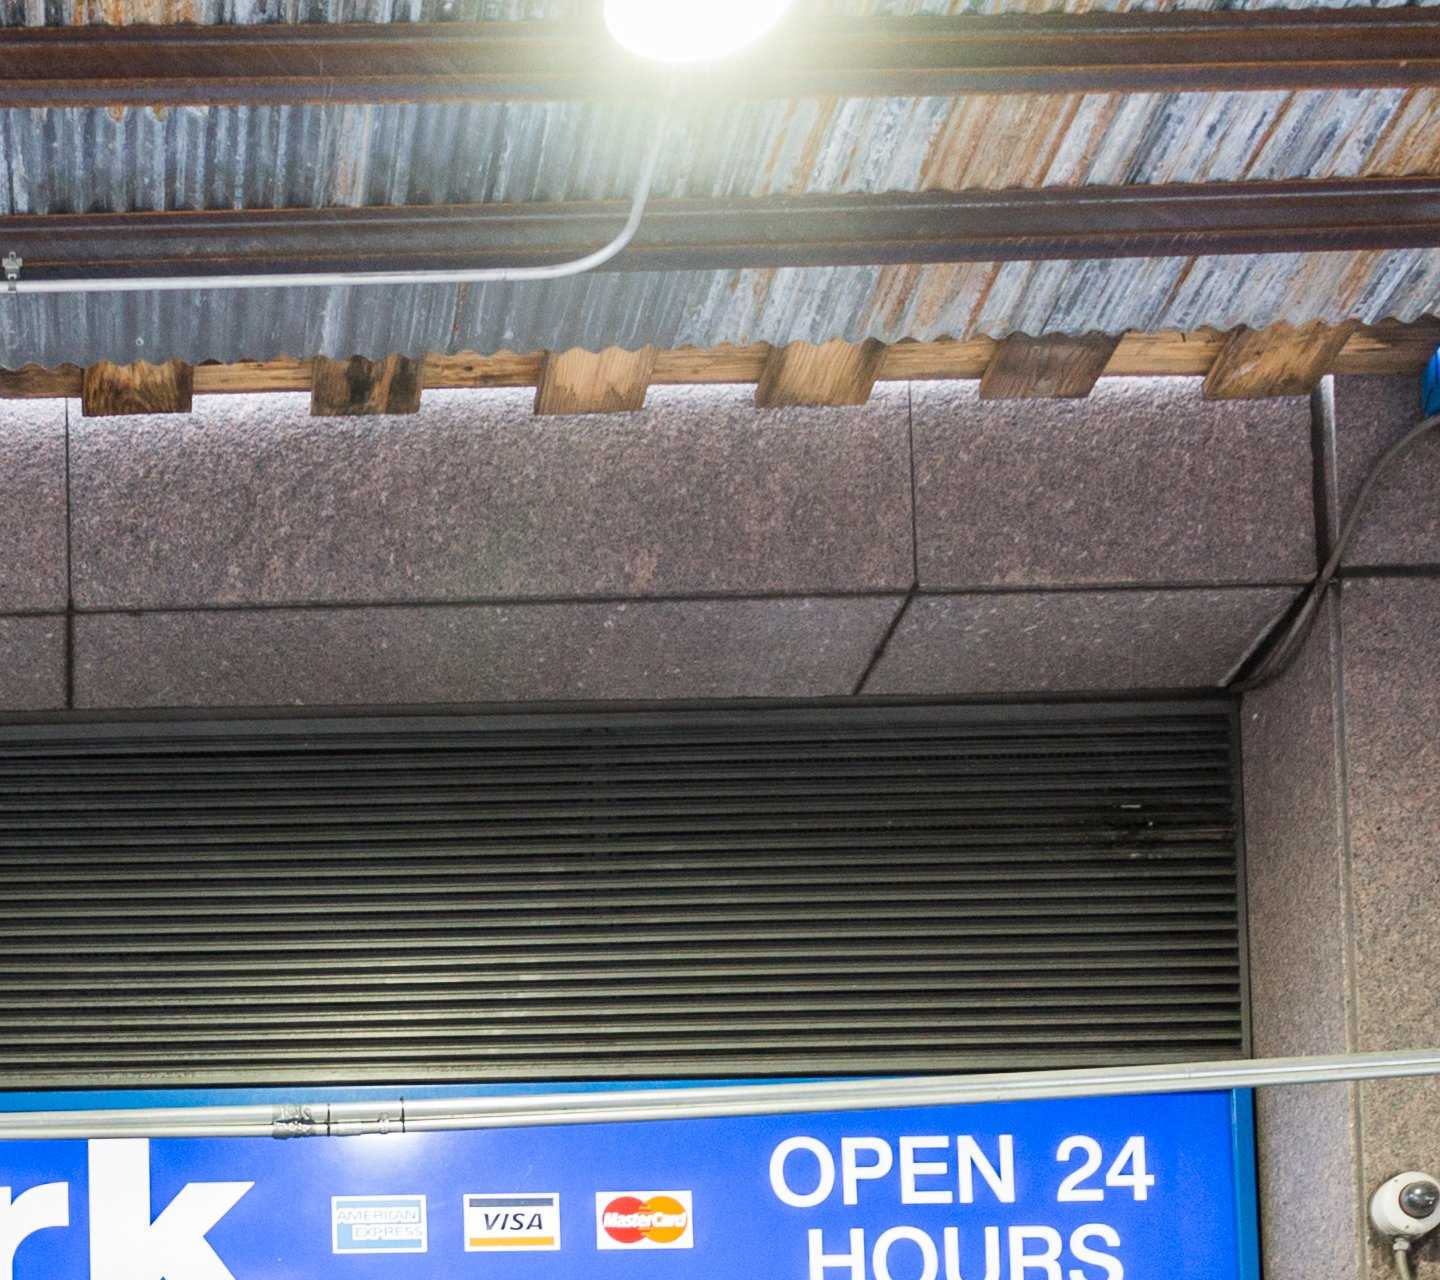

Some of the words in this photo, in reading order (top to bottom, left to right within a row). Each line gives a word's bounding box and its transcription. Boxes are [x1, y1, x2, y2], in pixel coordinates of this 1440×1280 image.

[769, 1136, 1014, 1209] OPEN
[1056, 1135, 1154, 1203] 24
[337, 1207, 417, 1224] AMERICAN
[483, 1213, 544, 1231] VISA
[603, 1210, 687, 1228] MasterCard
[353, 1225, 424, 1238] EXPRESS
